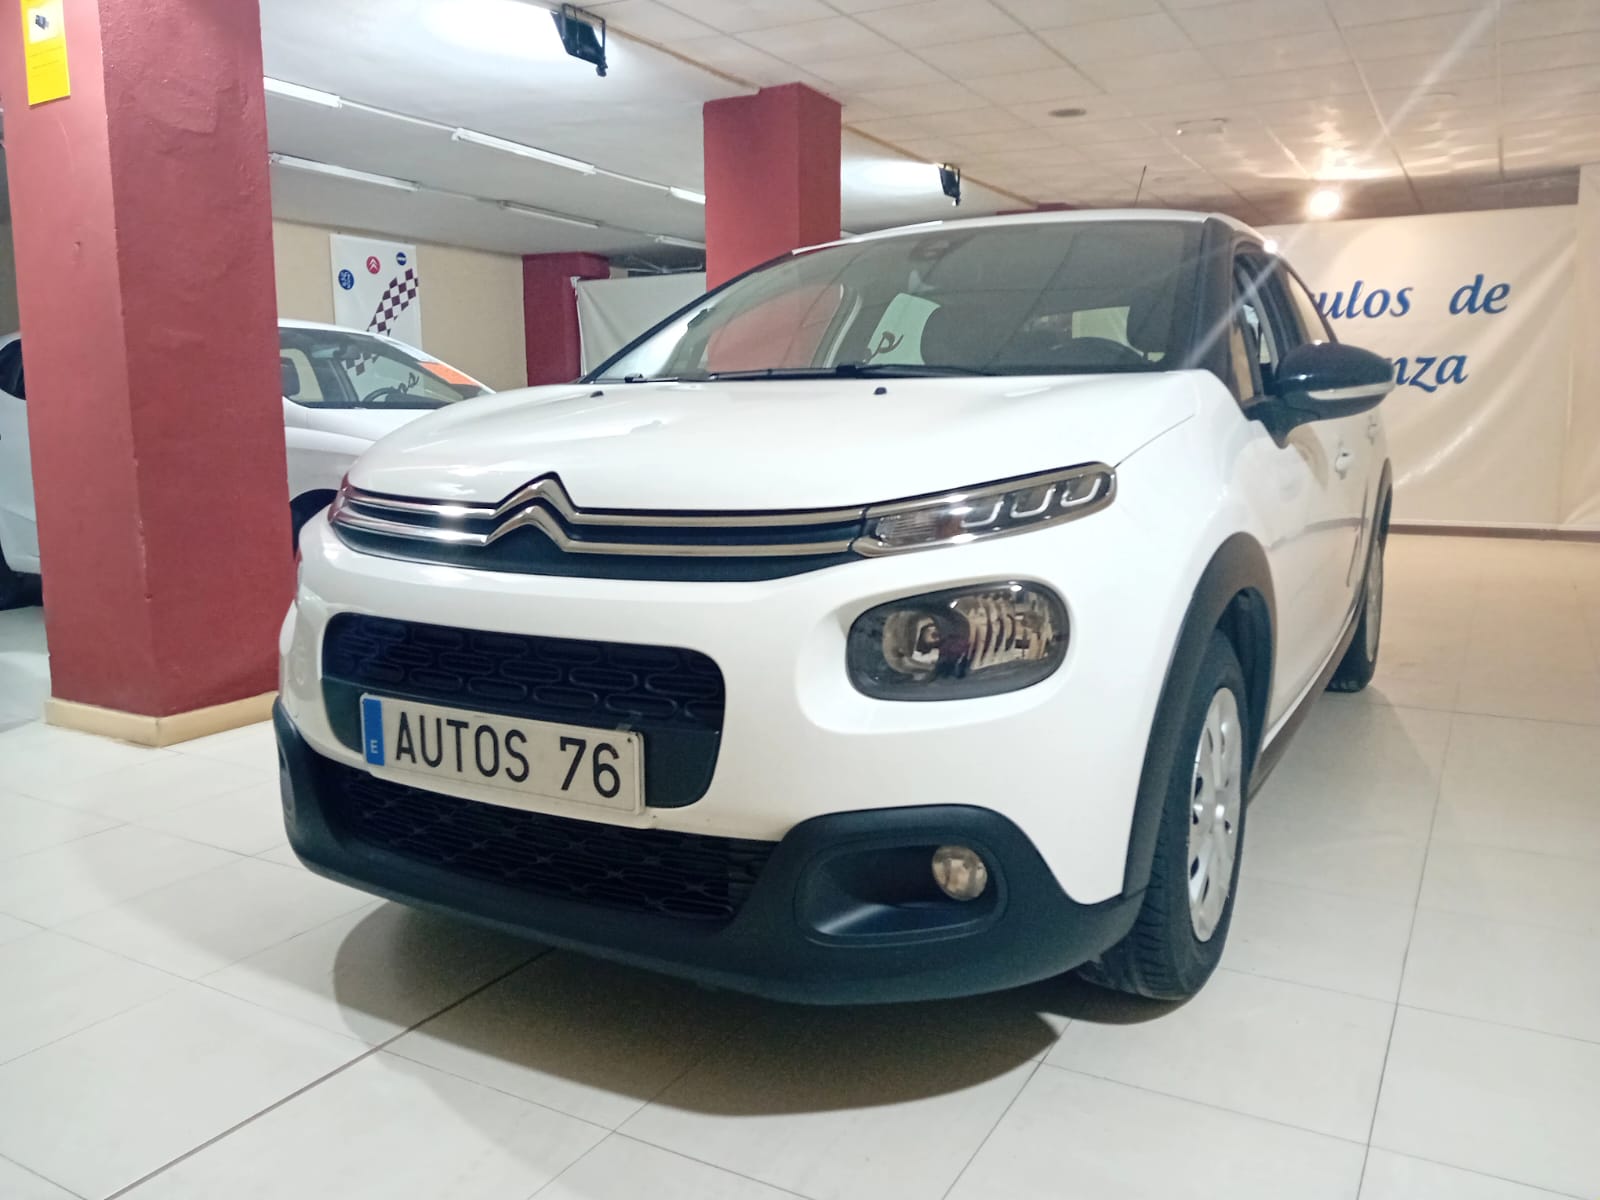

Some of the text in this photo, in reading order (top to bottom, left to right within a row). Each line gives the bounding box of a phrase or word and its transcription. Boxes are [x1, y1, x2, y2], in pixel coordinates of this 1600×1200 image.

[1309, 274, 1510, 319] ulos de
[370, 711, 621, 798] E AUTOS 76
